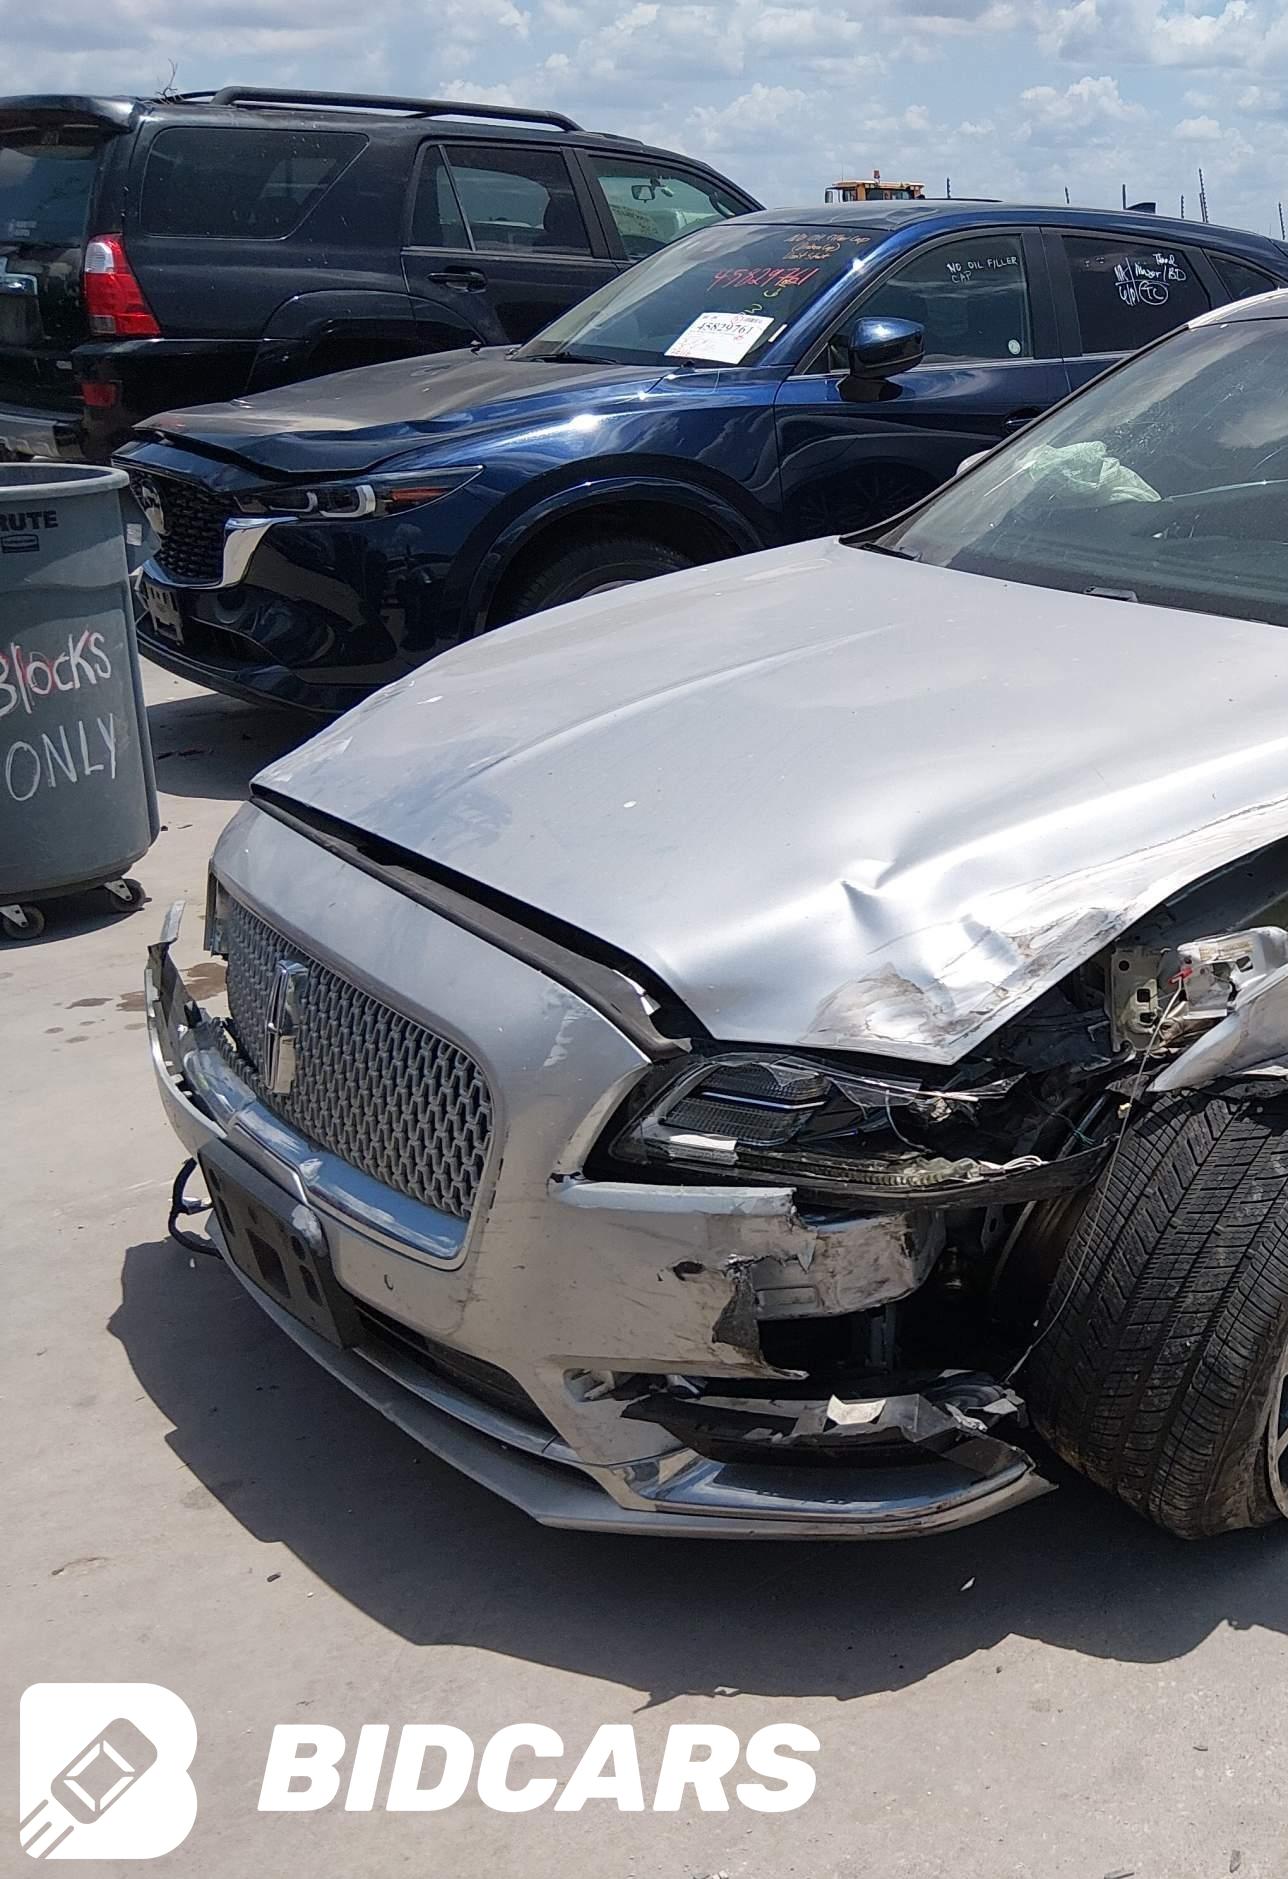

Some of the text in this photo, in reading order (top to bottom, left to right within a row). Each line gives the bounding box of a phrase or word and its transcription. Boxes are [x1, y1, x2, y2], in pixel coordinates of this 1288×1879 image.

[946, 256, 1018, 273] NO OIL FILLER
[951, 270, 972, 284] CAP
[5, 712, 116, 801] ONLY
